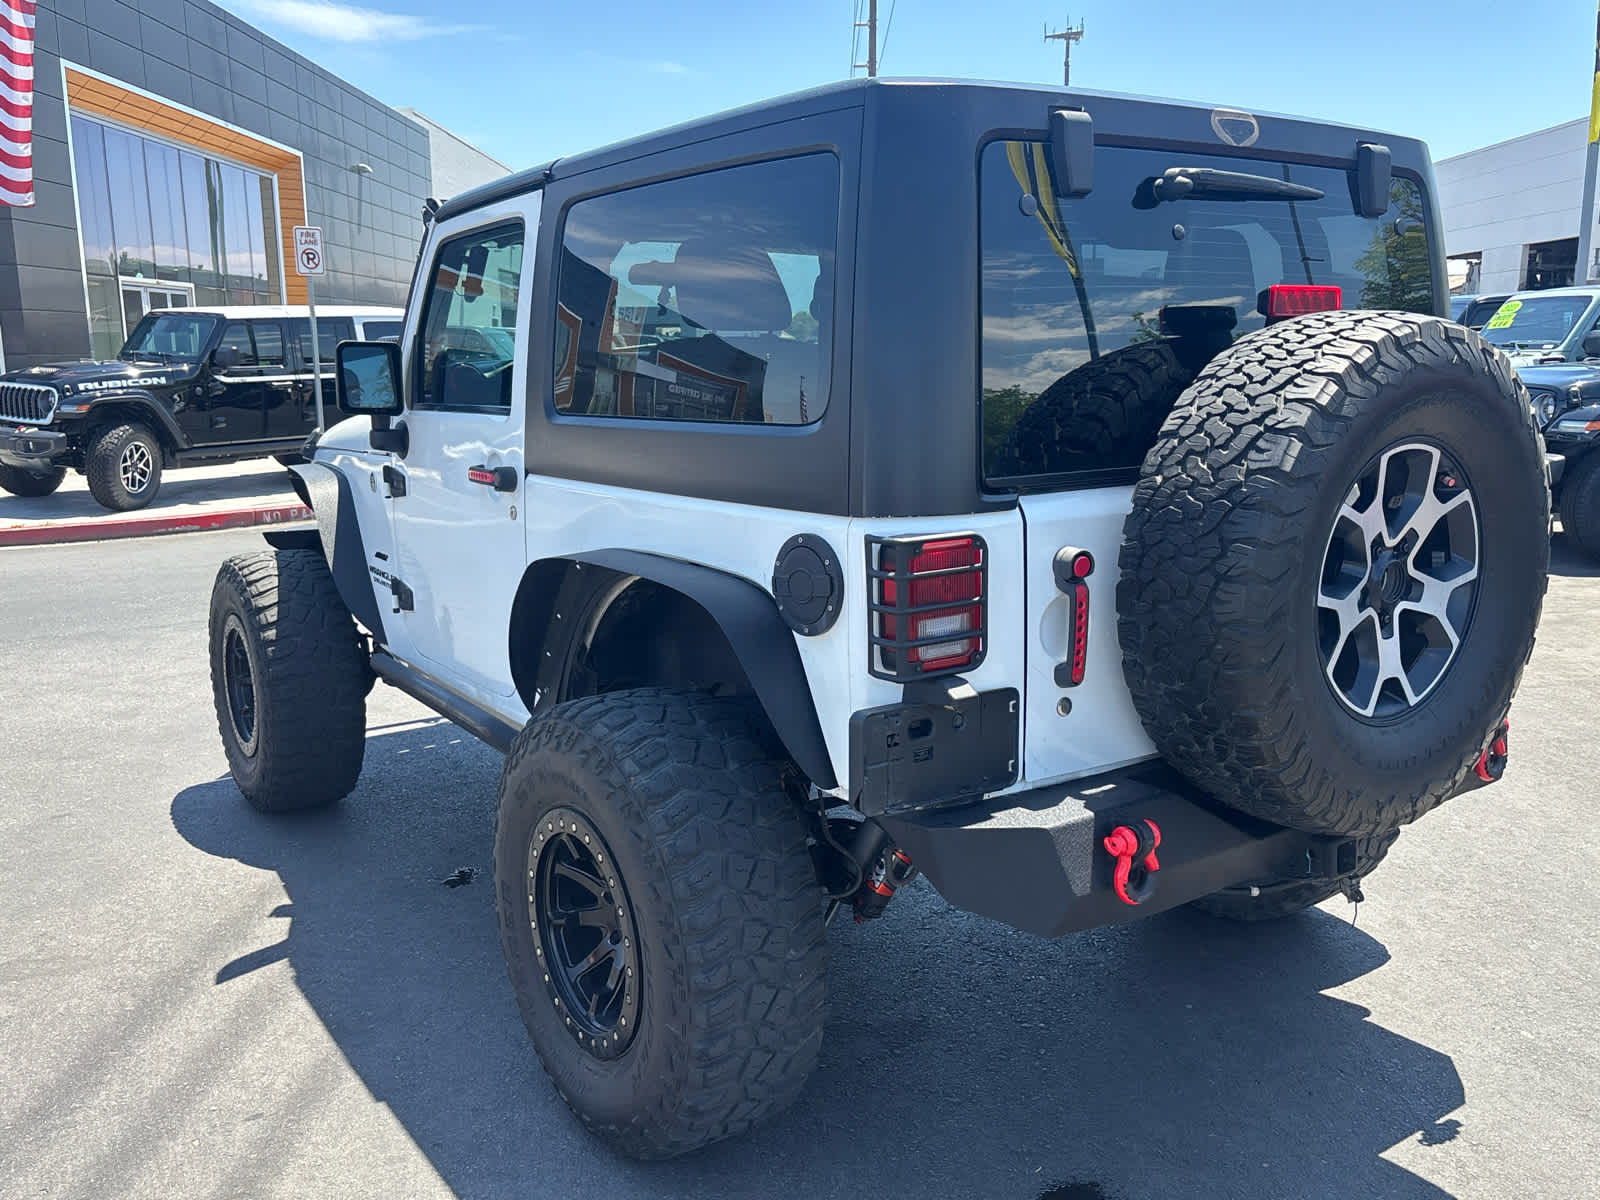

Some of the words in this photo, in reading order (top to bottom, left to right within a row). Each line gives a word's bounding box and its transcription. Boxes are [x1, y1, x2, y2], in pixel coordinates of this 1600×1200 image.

[300, 231, 315, 239] FIRE
[77, 376, 167, 390] RUBICON
[263, 511, 280, 522] NO
